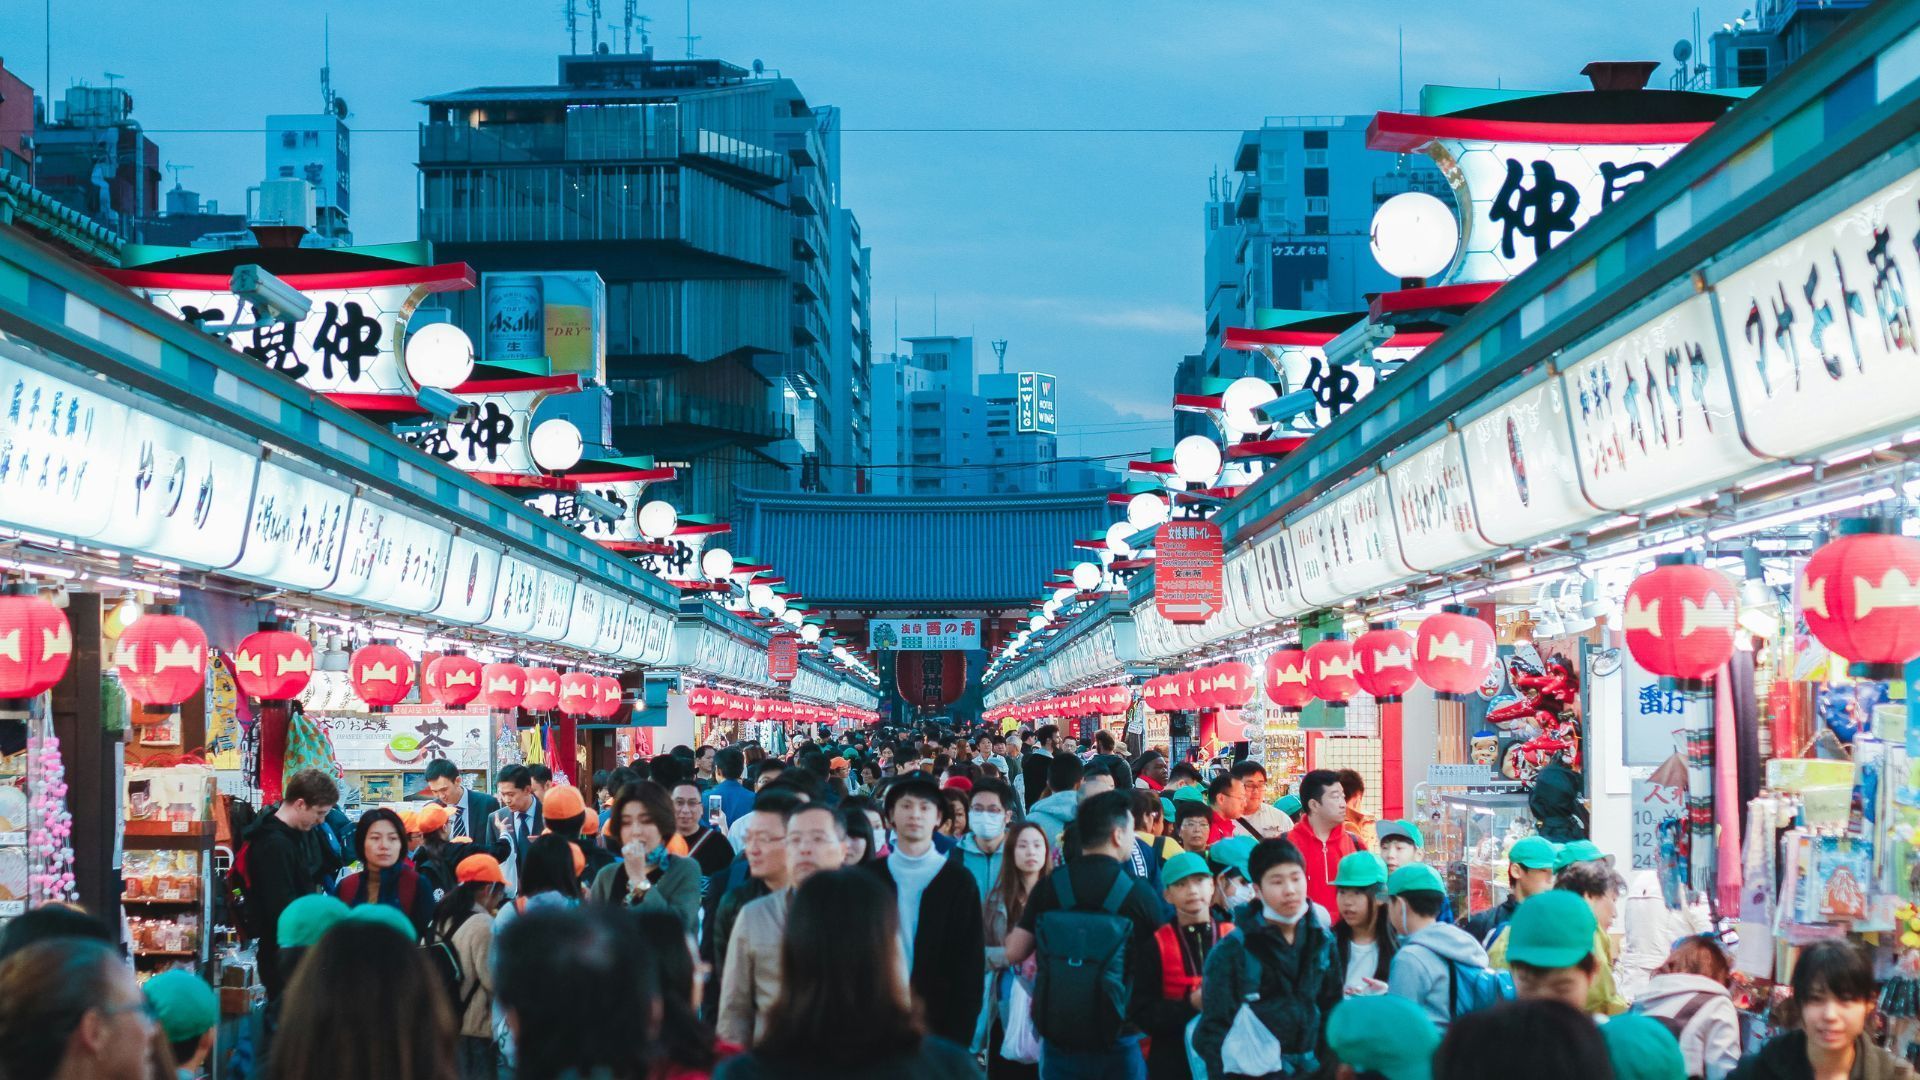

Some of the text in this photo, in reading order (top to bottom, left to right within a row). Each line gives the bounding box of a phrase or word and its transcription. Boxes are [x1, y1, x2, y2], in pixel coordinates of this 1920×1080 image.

[488, 310, 539, 333] Asahi
[507, 341, 521, 352] 生
[1022, 394, 1032, 426] WING
[1039, 400, 1053, 410] HOTEL
[1039, 411, 1055, 425] WING
[1168, 527, 1210, 540] 女性専用トイレ
[414, 717, 454, 759] 茶
[1633, 832, 1654, 847] 12
[1633, 854, 1651, 869] 24
